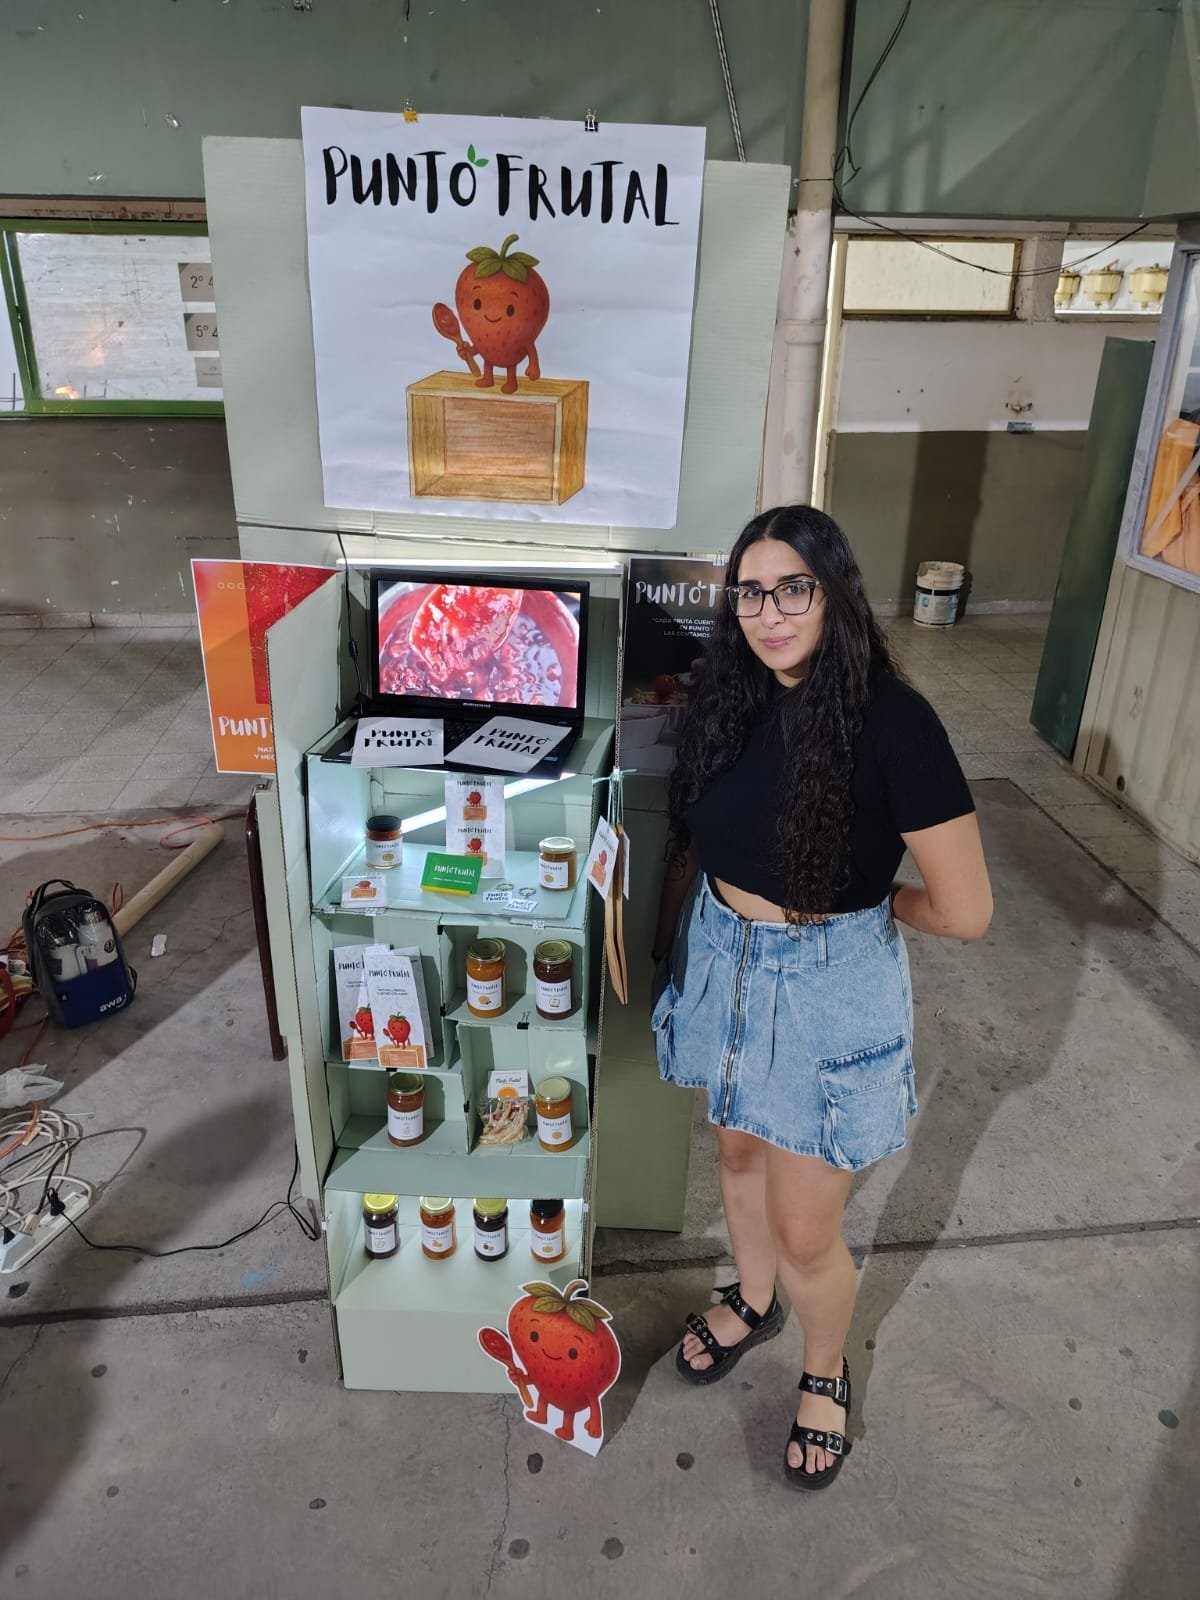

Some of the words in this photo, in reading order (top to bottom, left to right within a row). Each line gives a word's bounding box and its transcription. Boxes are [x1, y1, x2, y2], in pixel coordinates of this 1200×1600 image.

[322, 146, 478, 214] PUNTO
[495, 152, 681, 226] FRUTAL
[635, 581, 704, 607] PUNTO
[218, 715, 273, 738] PUNT
[371, 728, 435, 738] PUNTO
[488, 727, 551, 745] PUNTO
[364, 738, 436, 747] FRUTAL
[473, 735, 541, 754] FRUTAL
